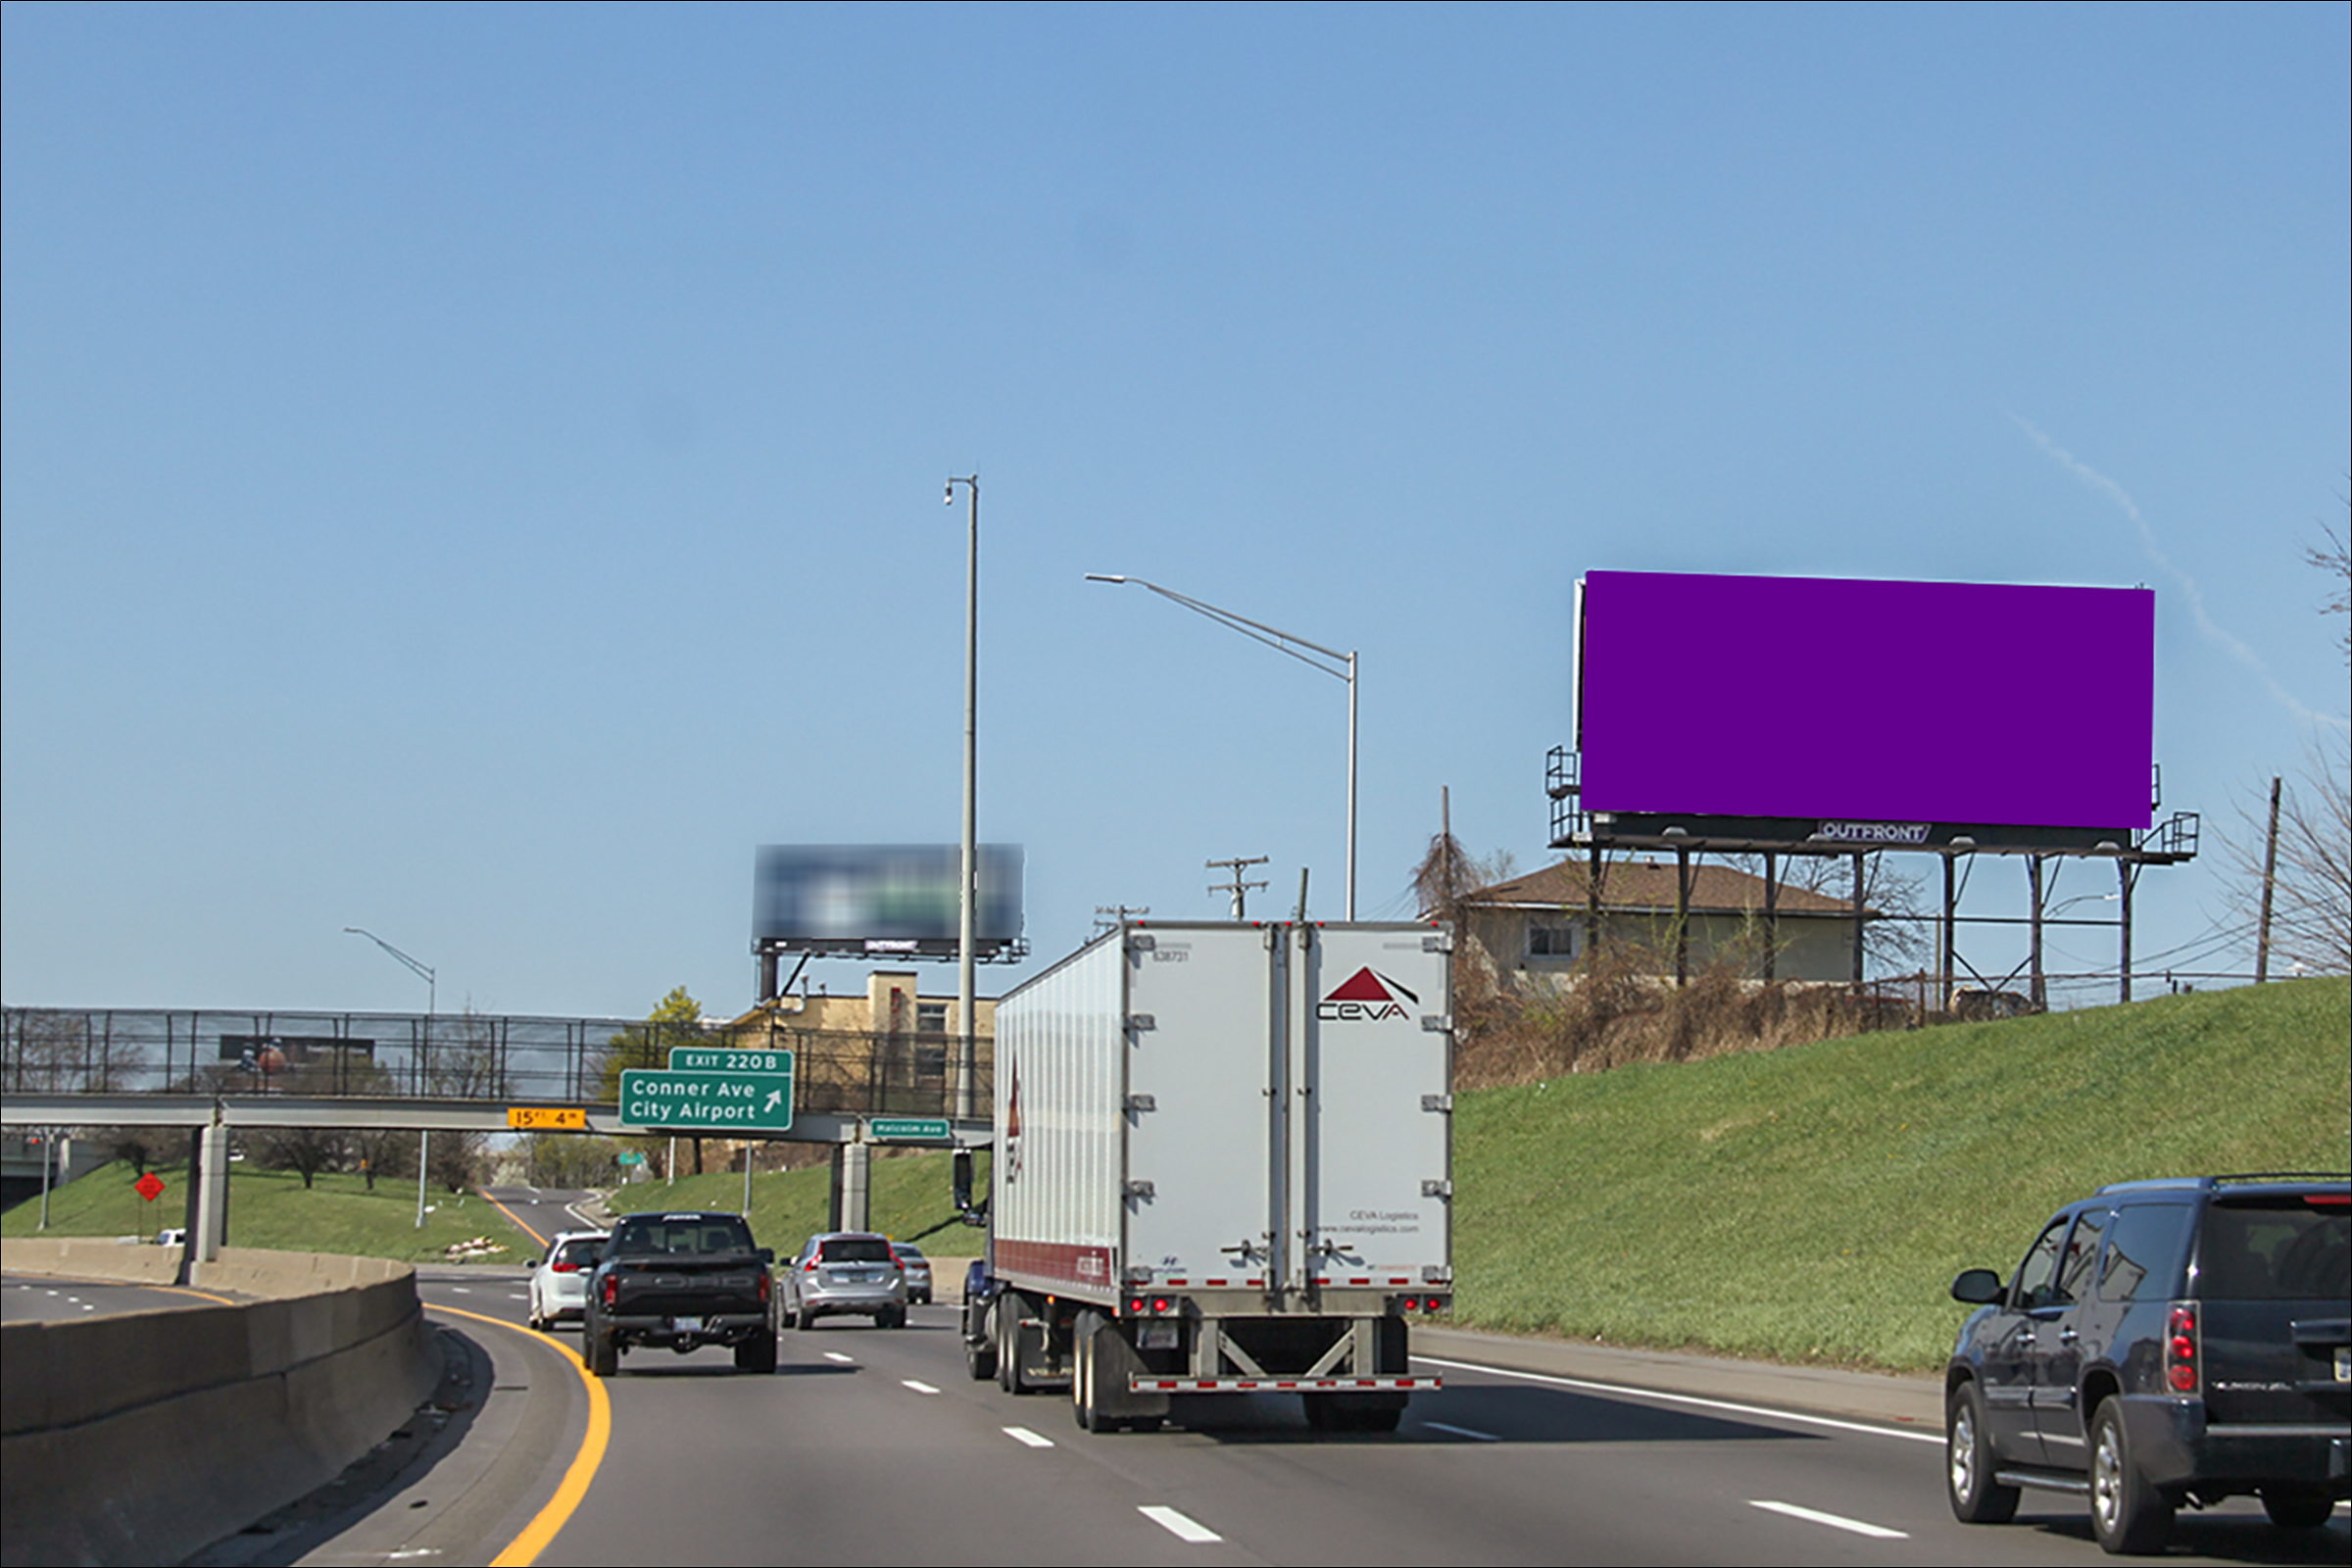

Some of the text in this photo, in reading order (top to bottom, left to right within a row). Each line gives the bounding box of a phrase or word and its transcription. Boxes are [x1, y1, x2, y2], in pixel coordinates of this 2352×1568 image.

[1823, 822, 1925, 841] OUTFRONT
[686, 1054, 777, 1070] EXIT 220B
[632, 1080, 756, 1098] Conner Ave
[630, 1101, 756, 1122] City Airport
[923, 1124, 943, 1133] Ave
